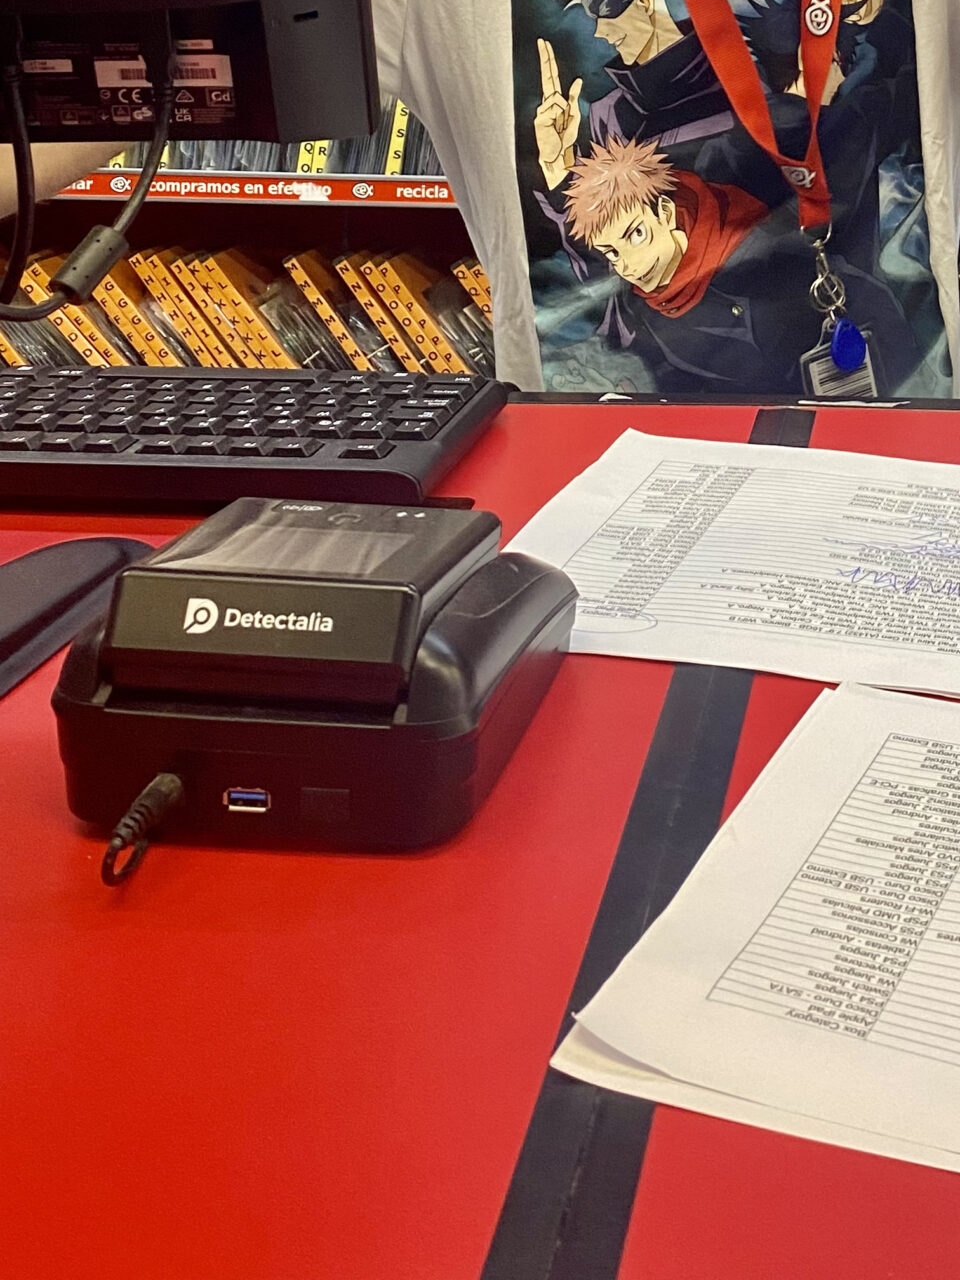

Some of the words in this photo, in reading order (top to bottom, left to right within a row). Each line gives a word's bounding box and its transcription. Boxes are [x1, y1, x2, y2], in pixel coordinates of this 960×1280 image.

[148, 179, 241, 195] compramos
[243, 182, 265, 195] en
[395, 182, 449, 199] recicla
[223, 607, 334, 633] Detectalia
